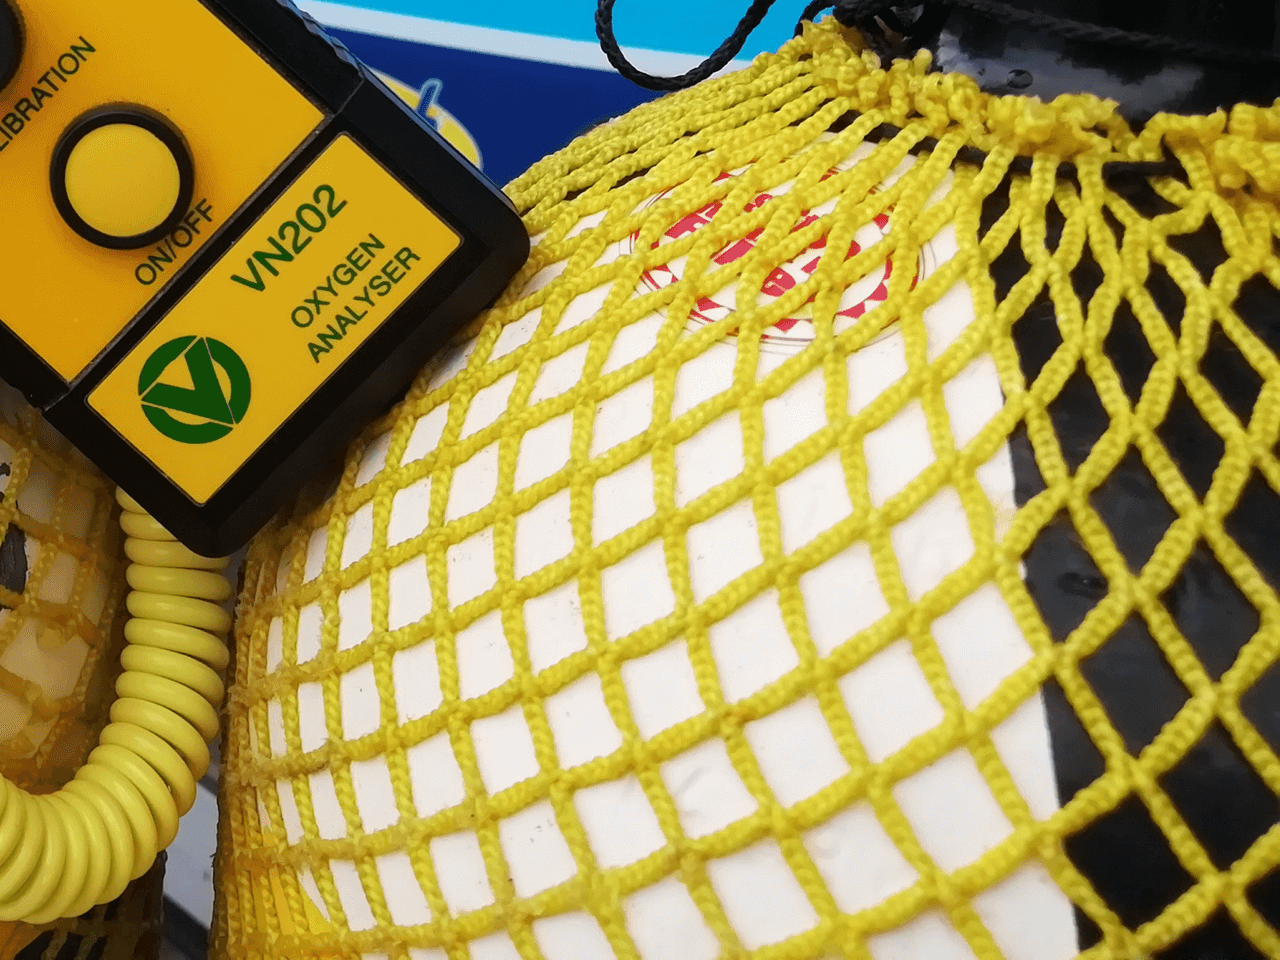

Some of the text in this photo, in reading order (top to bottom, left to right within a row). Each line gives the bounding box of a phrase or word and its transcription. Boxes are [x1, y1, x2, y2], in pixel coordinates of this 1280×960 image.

[134, 198, 216, 287] ON/OFF
[230, 183, 348, 293] VN202
[290, 232, 386, 330] OXYGEN
[306, 245, 421, 364] ANALYSER
